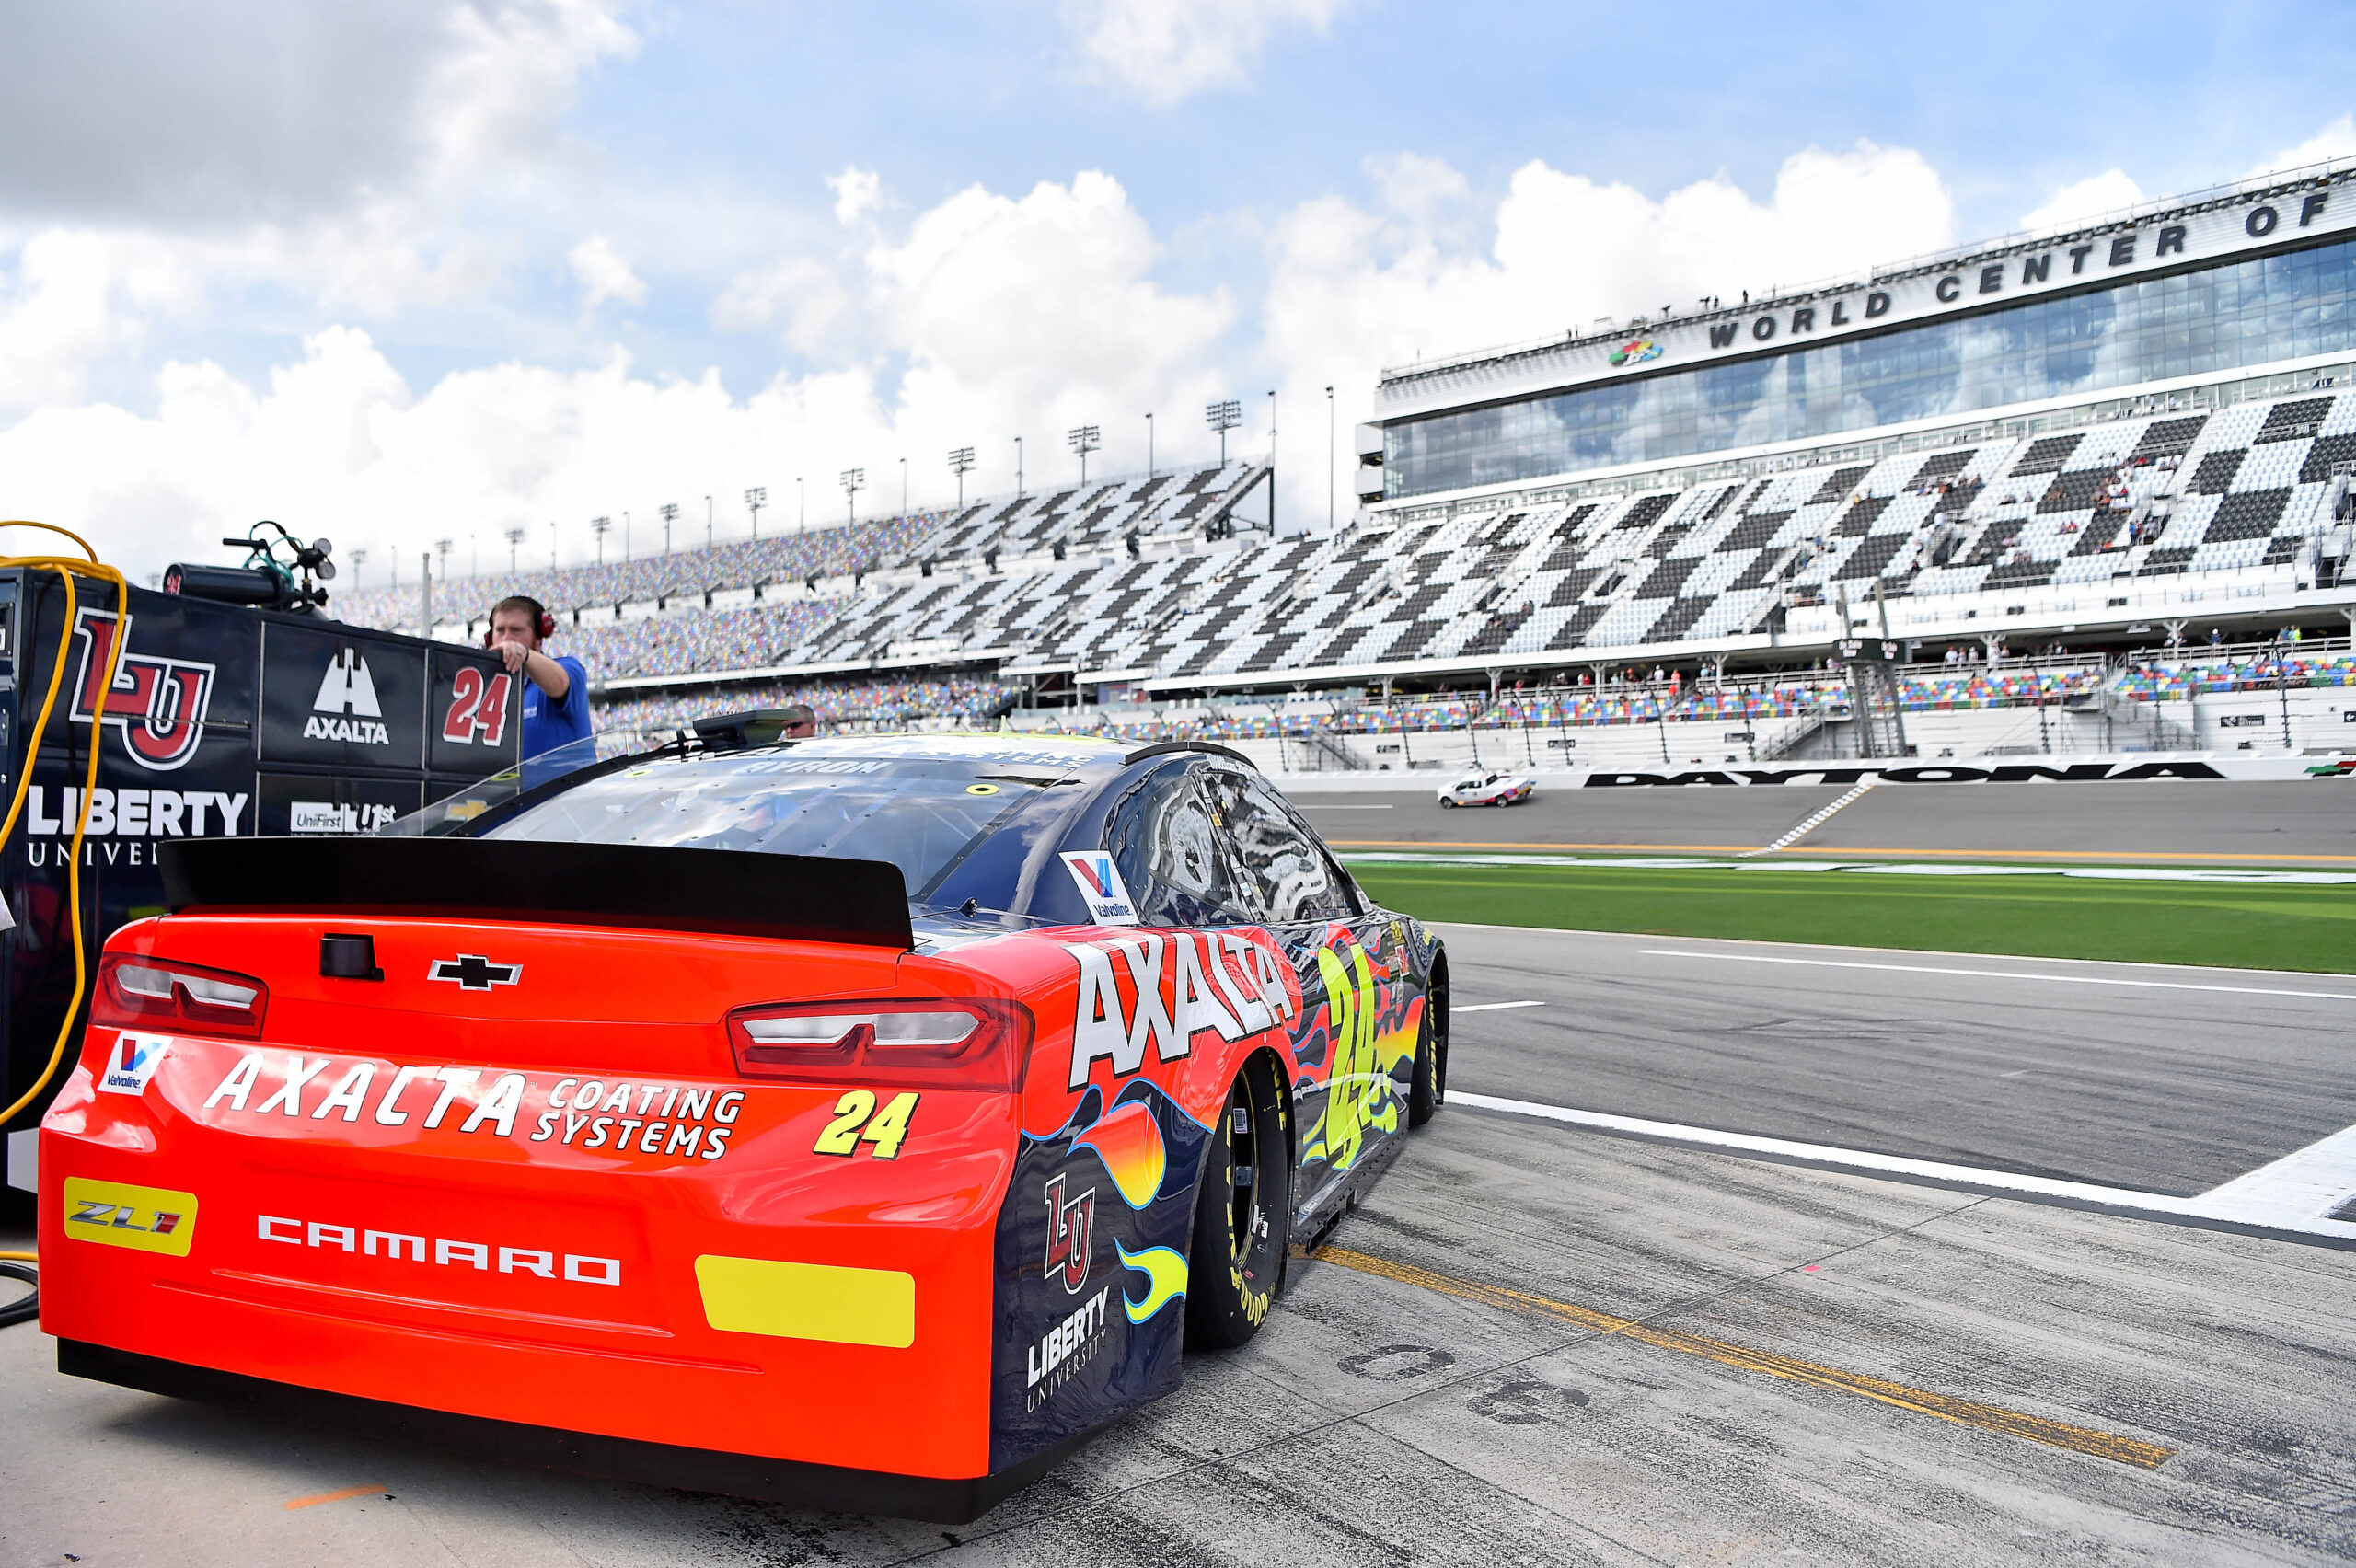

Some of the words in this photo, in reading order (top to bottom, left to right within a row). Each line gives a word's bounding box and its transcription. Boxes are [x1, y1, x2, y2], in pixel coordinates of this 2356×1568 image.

[1709, 292, 1891, 350] WORLD
[1936, 225, 2187, 303] CENTER
[2246, 191, 2329, 237] OF
[303, 715, 390, 744] AXALTA
[443, 667, 512, 746] 24
[733, 760, 893, 774] BYRON
[1582, 762, 2228, 787] DAYTONA
[27, 785, 248, 836] LIBERTY
[296, 812, 341, 828] UniFirst
[28, 841, 158, 867] UNIVE
[1092, 903, 1131, 917] Valvoline
[1062, 930, 1296, 1094] AXALTA
[1318, 941, 1376, 1157] 24
[108, 1074, 141, 1088] Valvoline
[202, 1053, 527, 1138] AXALTA
[548, 1078, 746, 1124] COATING
[530, 1111, 733, 1160] SYSTEMS
[813, 1090, 921, 1161] 24
[68, 1200, 183, 1236] ZL1
[258, 1215, 621, 1286] CAMARO
[1027, 1285, 1109, 1389] LIBERTY
[1026, 1328, 1107, 1414] UNIVERSITY
